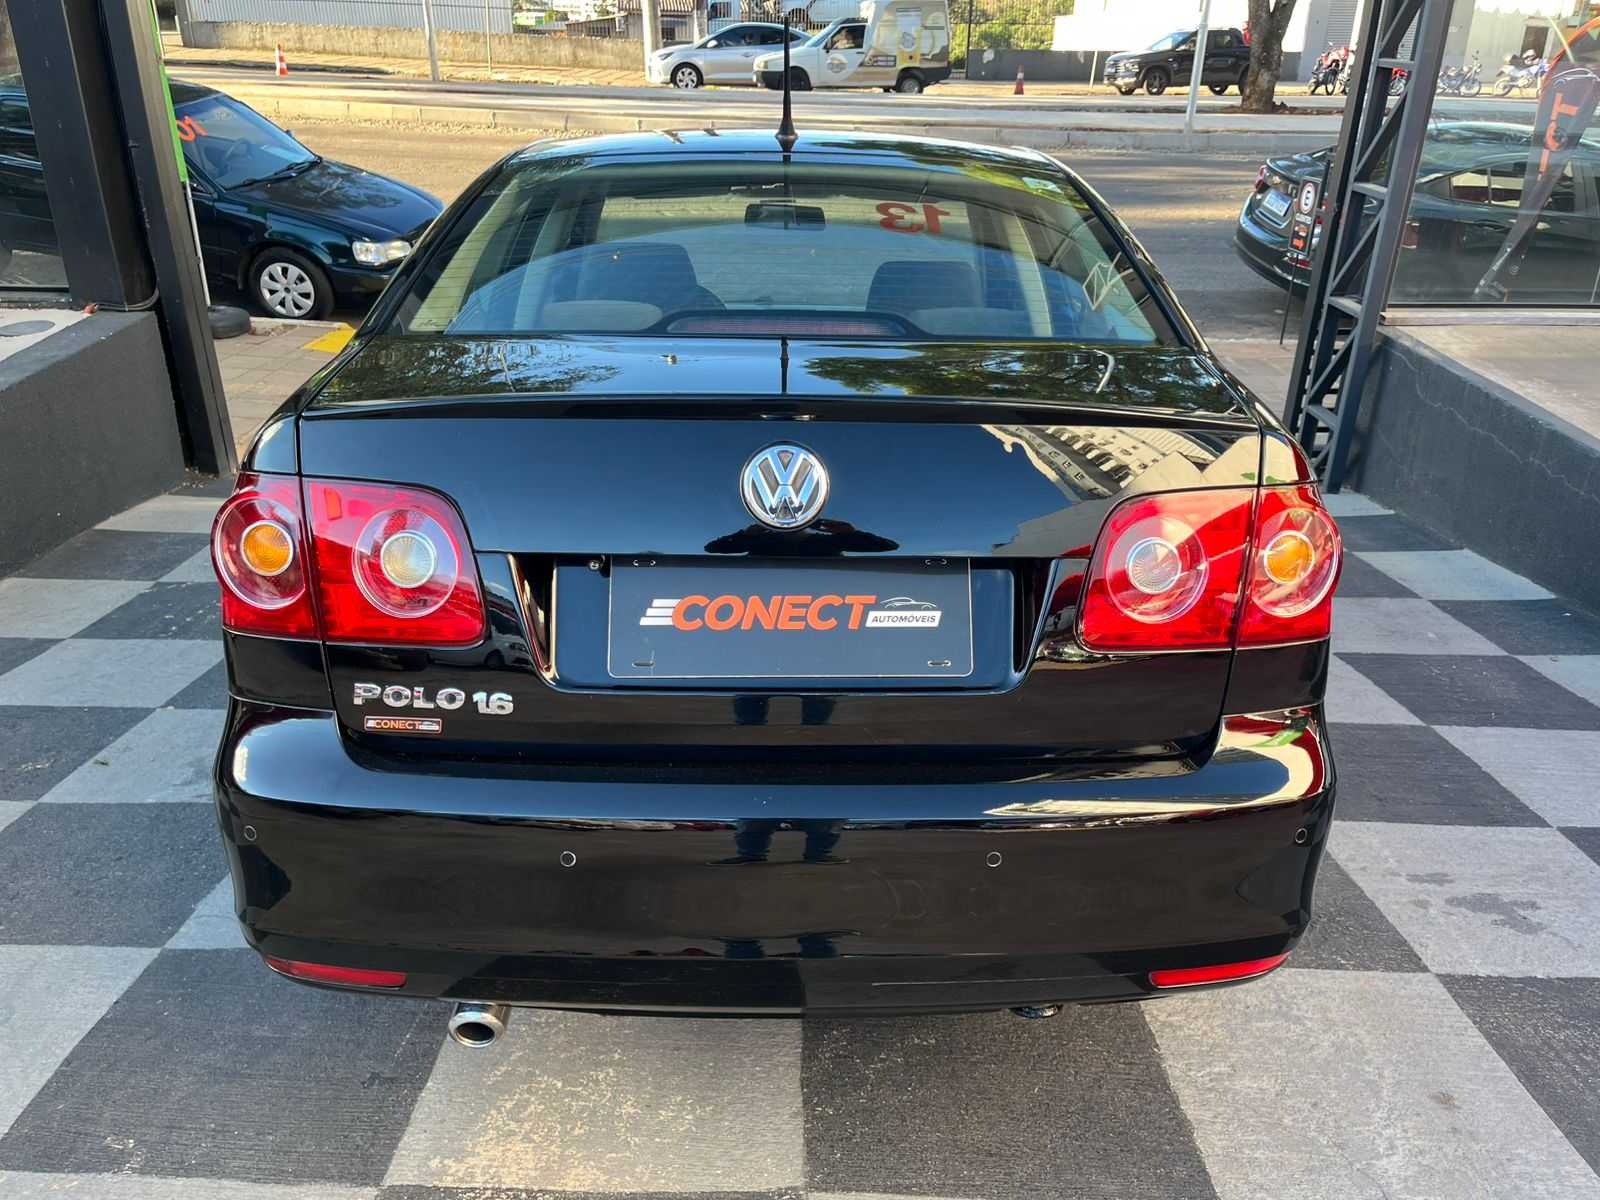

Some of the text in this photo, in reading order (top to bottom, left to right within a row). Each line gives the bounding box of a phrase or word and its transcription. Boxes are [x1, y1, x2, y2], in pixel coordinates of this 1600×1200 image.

[743, 444, 827, 528] VW
[671, 595, 936, 631] CONECT AUTOMÓVEIS
[353, 682, 466, 710] POLO
[373, 719, 421, 730] CONECT
